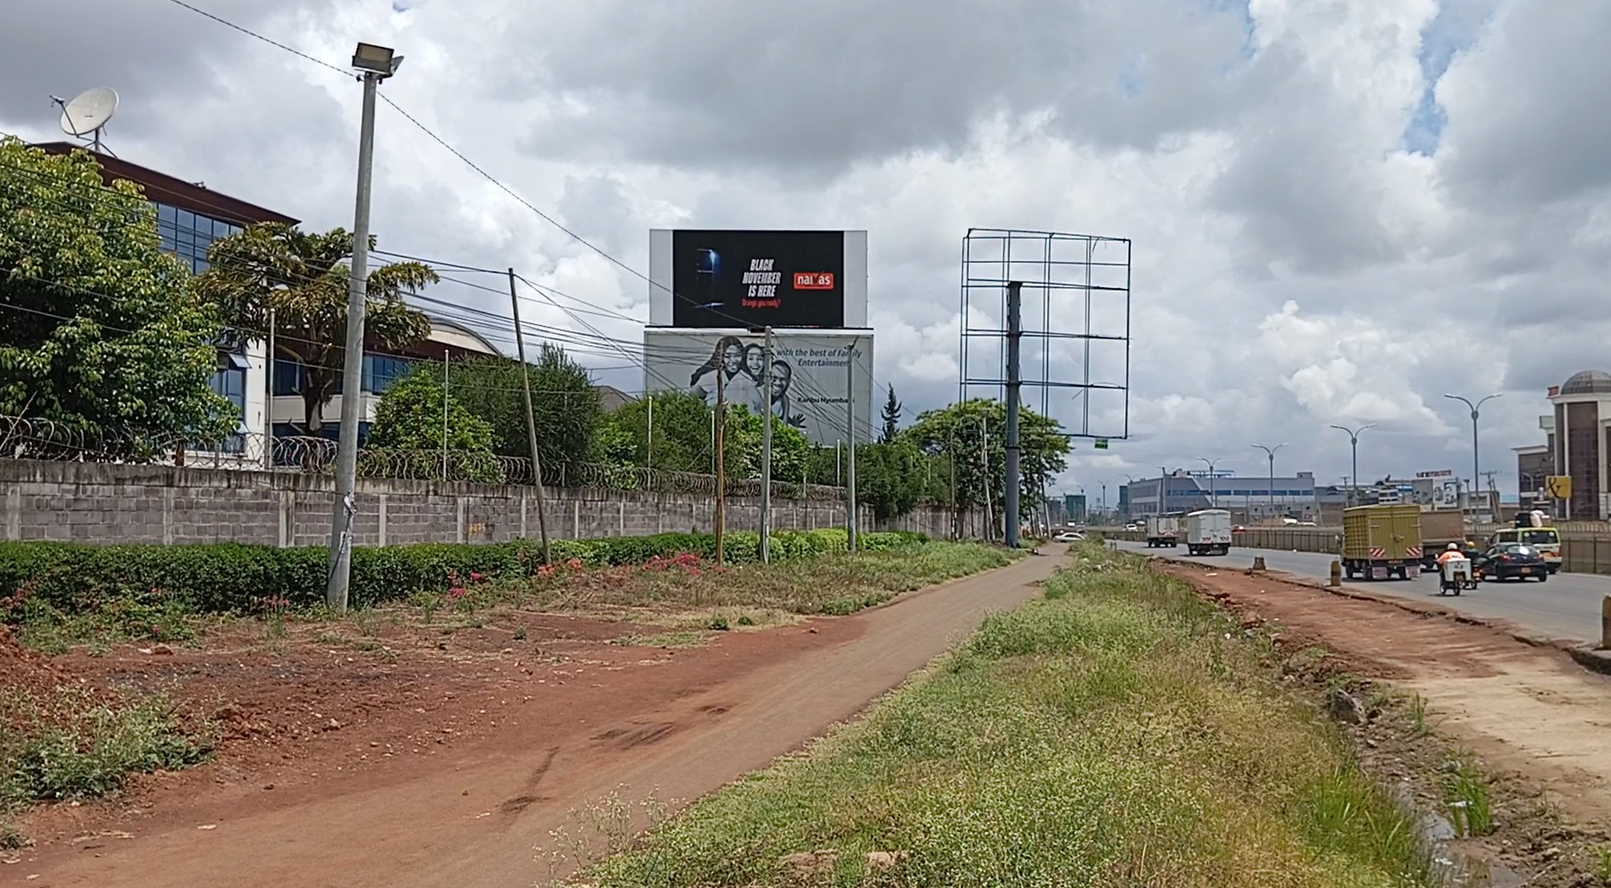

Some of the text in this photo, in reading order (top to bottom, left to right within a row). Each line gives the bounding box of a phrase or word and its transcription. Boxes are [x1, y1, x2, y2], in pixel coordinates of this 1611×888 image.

[750, 259, 774, 271] BLACK
[742, 272, 781, 284] NOVEMBER
[748, 285, 776, 297] IS HERE
[777, 348, 794, 357] with
[795, 349, 808, 357] the
[809, 349, 826, 357] best
[828, 349, 837, 357] of
[798, 359, 849, 367] Entertainmen
